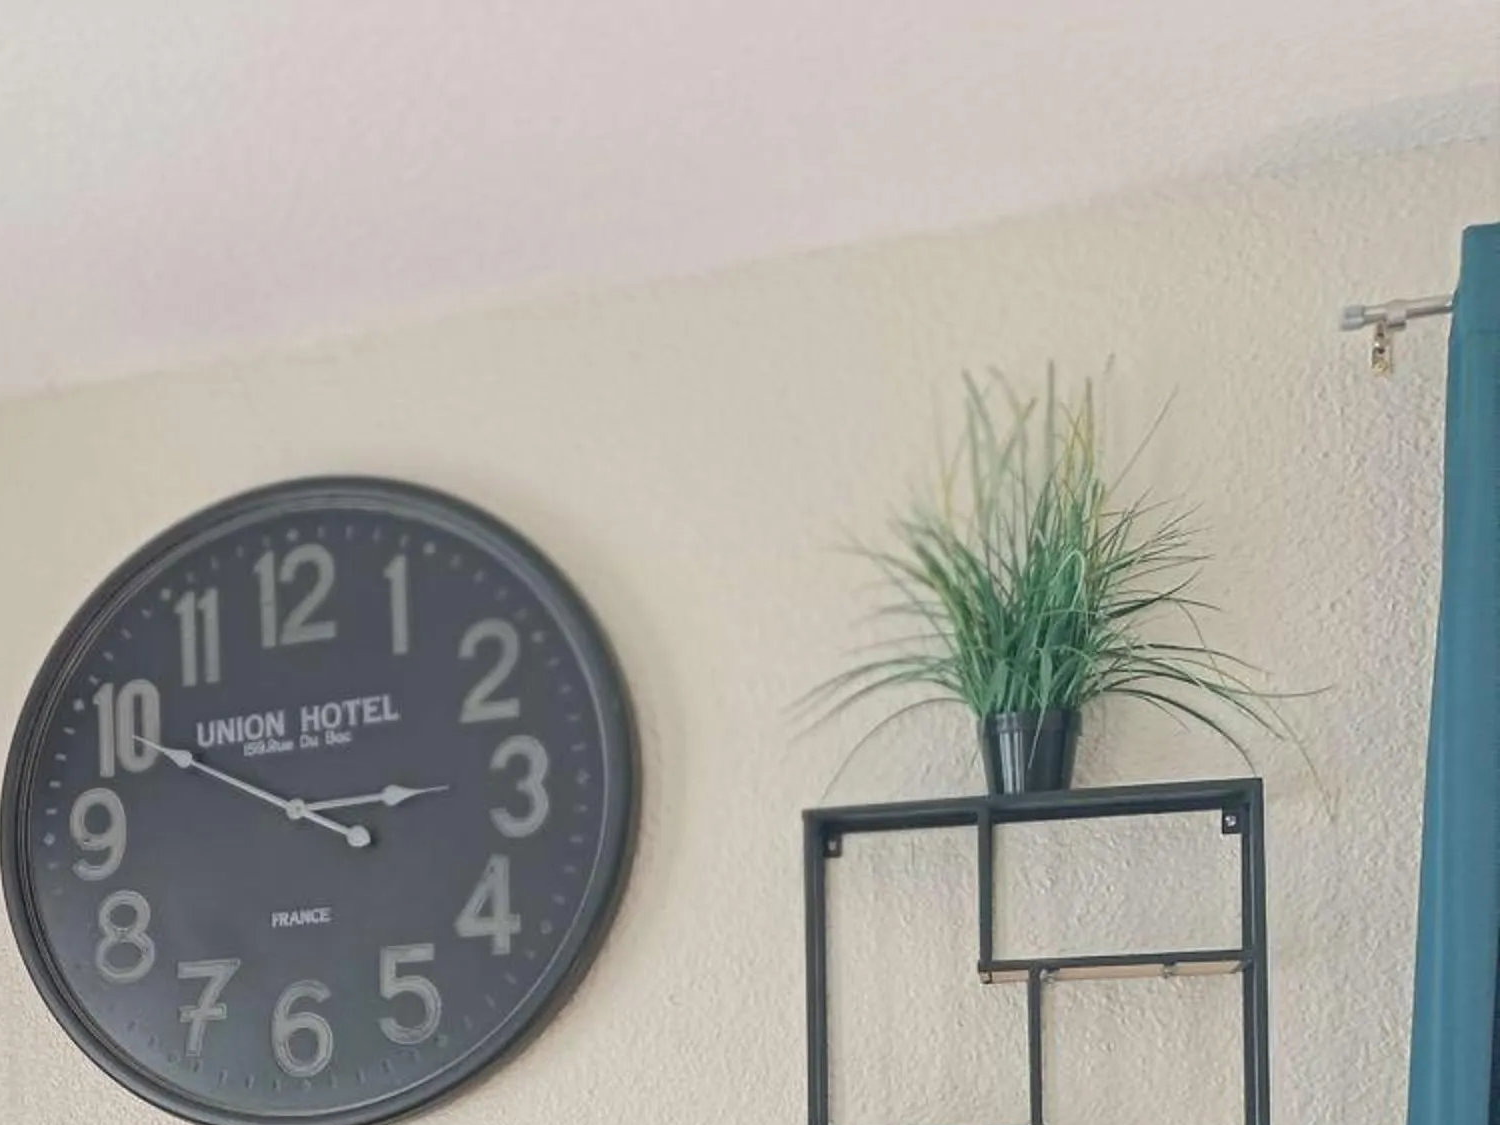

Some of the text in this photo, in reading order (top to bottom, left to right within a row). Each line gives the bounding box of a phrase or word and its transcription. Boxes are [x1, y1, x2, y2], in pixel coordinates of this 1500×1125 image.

[173, 587, 221, 687] 11
[253, 542, 337, 649] 12
[382, 554, 410, 655] 1
[457, 617, 521, 724] 2
[92, 677, 161, 777] 10
[196, 694, 400, 748] UNION HOTEL
[68, 786, 128, 881] 9
[489, 734, 549, 837] 3
[95, 889, 156, 984] 8
[271, 907, 332, 928] FRANCE
[454, 854, 521, 956] 4
[176, 958, 241, 1057] 7
[271, 979, 334, 1077] 6
[378, 942, 442, 1045] 5
